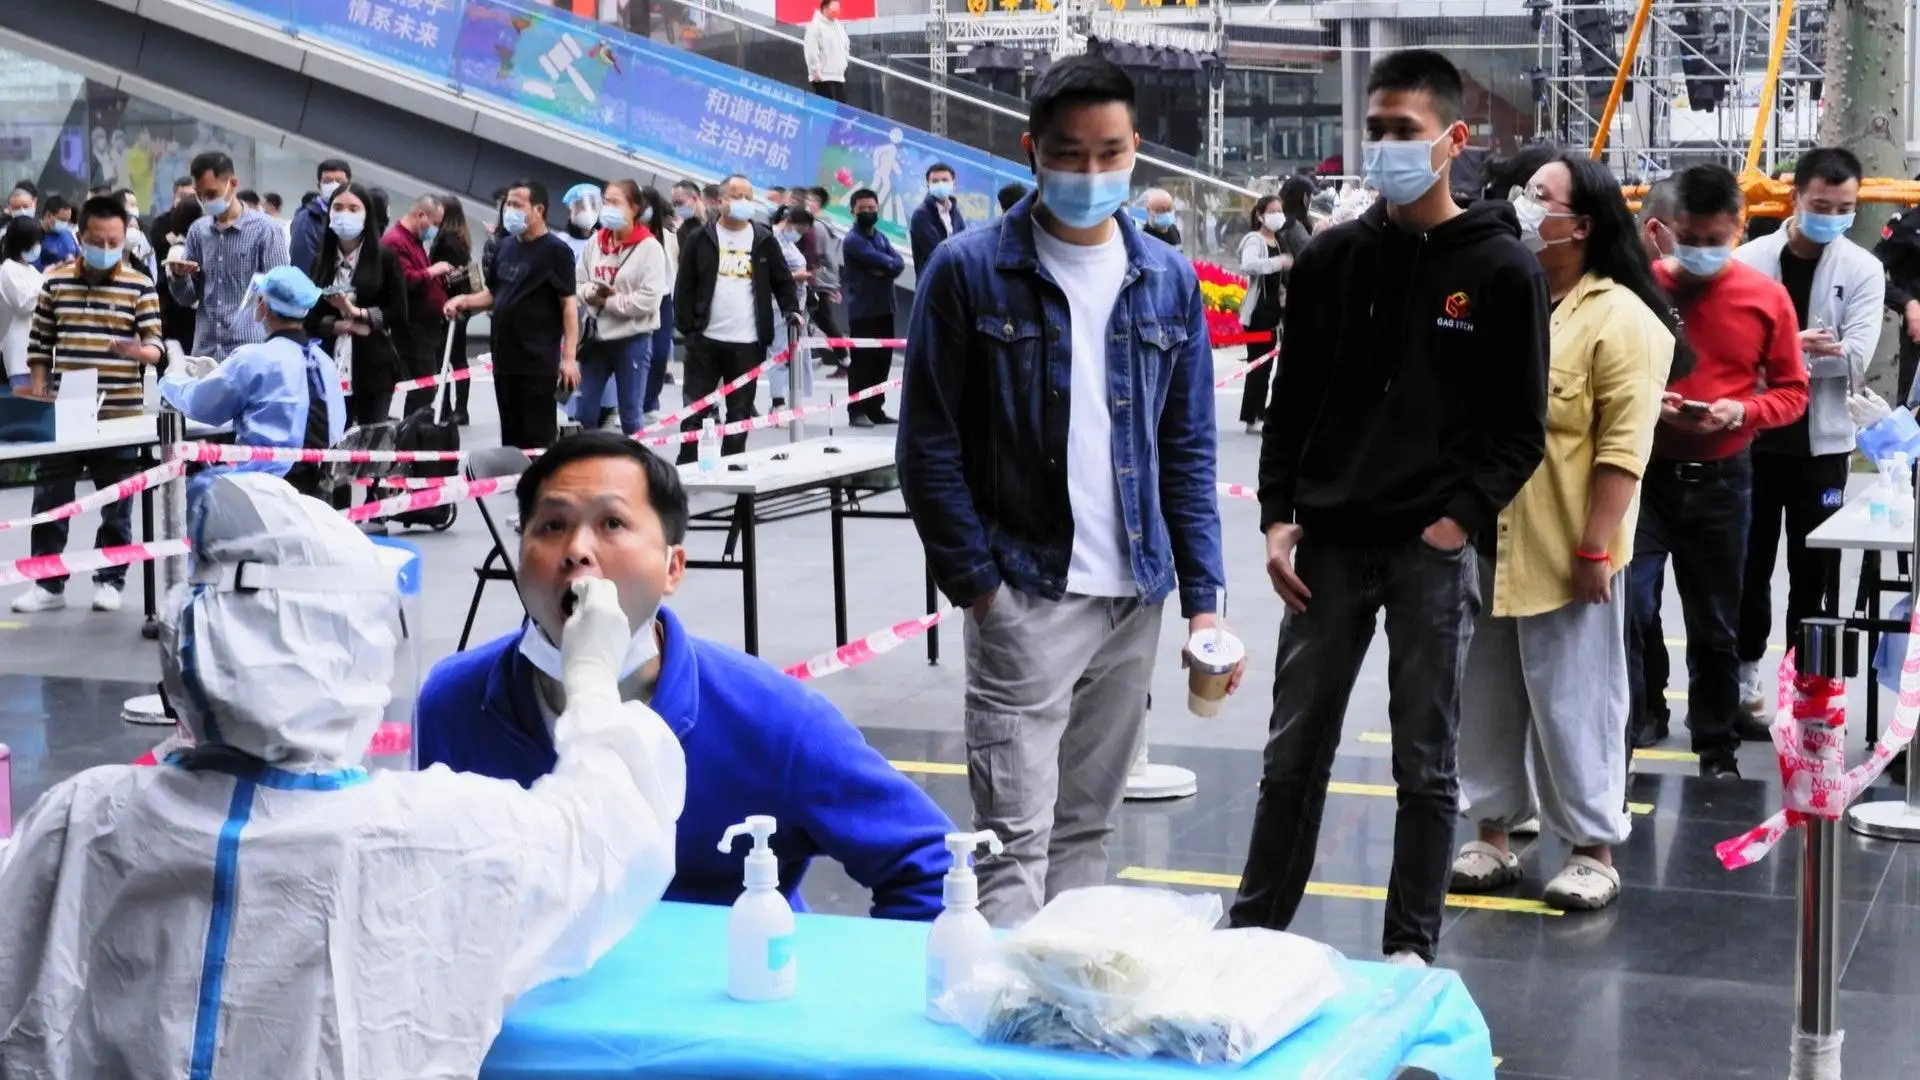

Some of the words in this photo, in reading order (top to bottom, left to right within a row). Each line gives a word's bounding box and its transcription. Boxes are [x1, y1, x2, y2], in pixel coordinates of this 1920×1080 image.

[705, 87, 801, 139] 和谐城市
[696, 117, 792, 171] 法治护航
